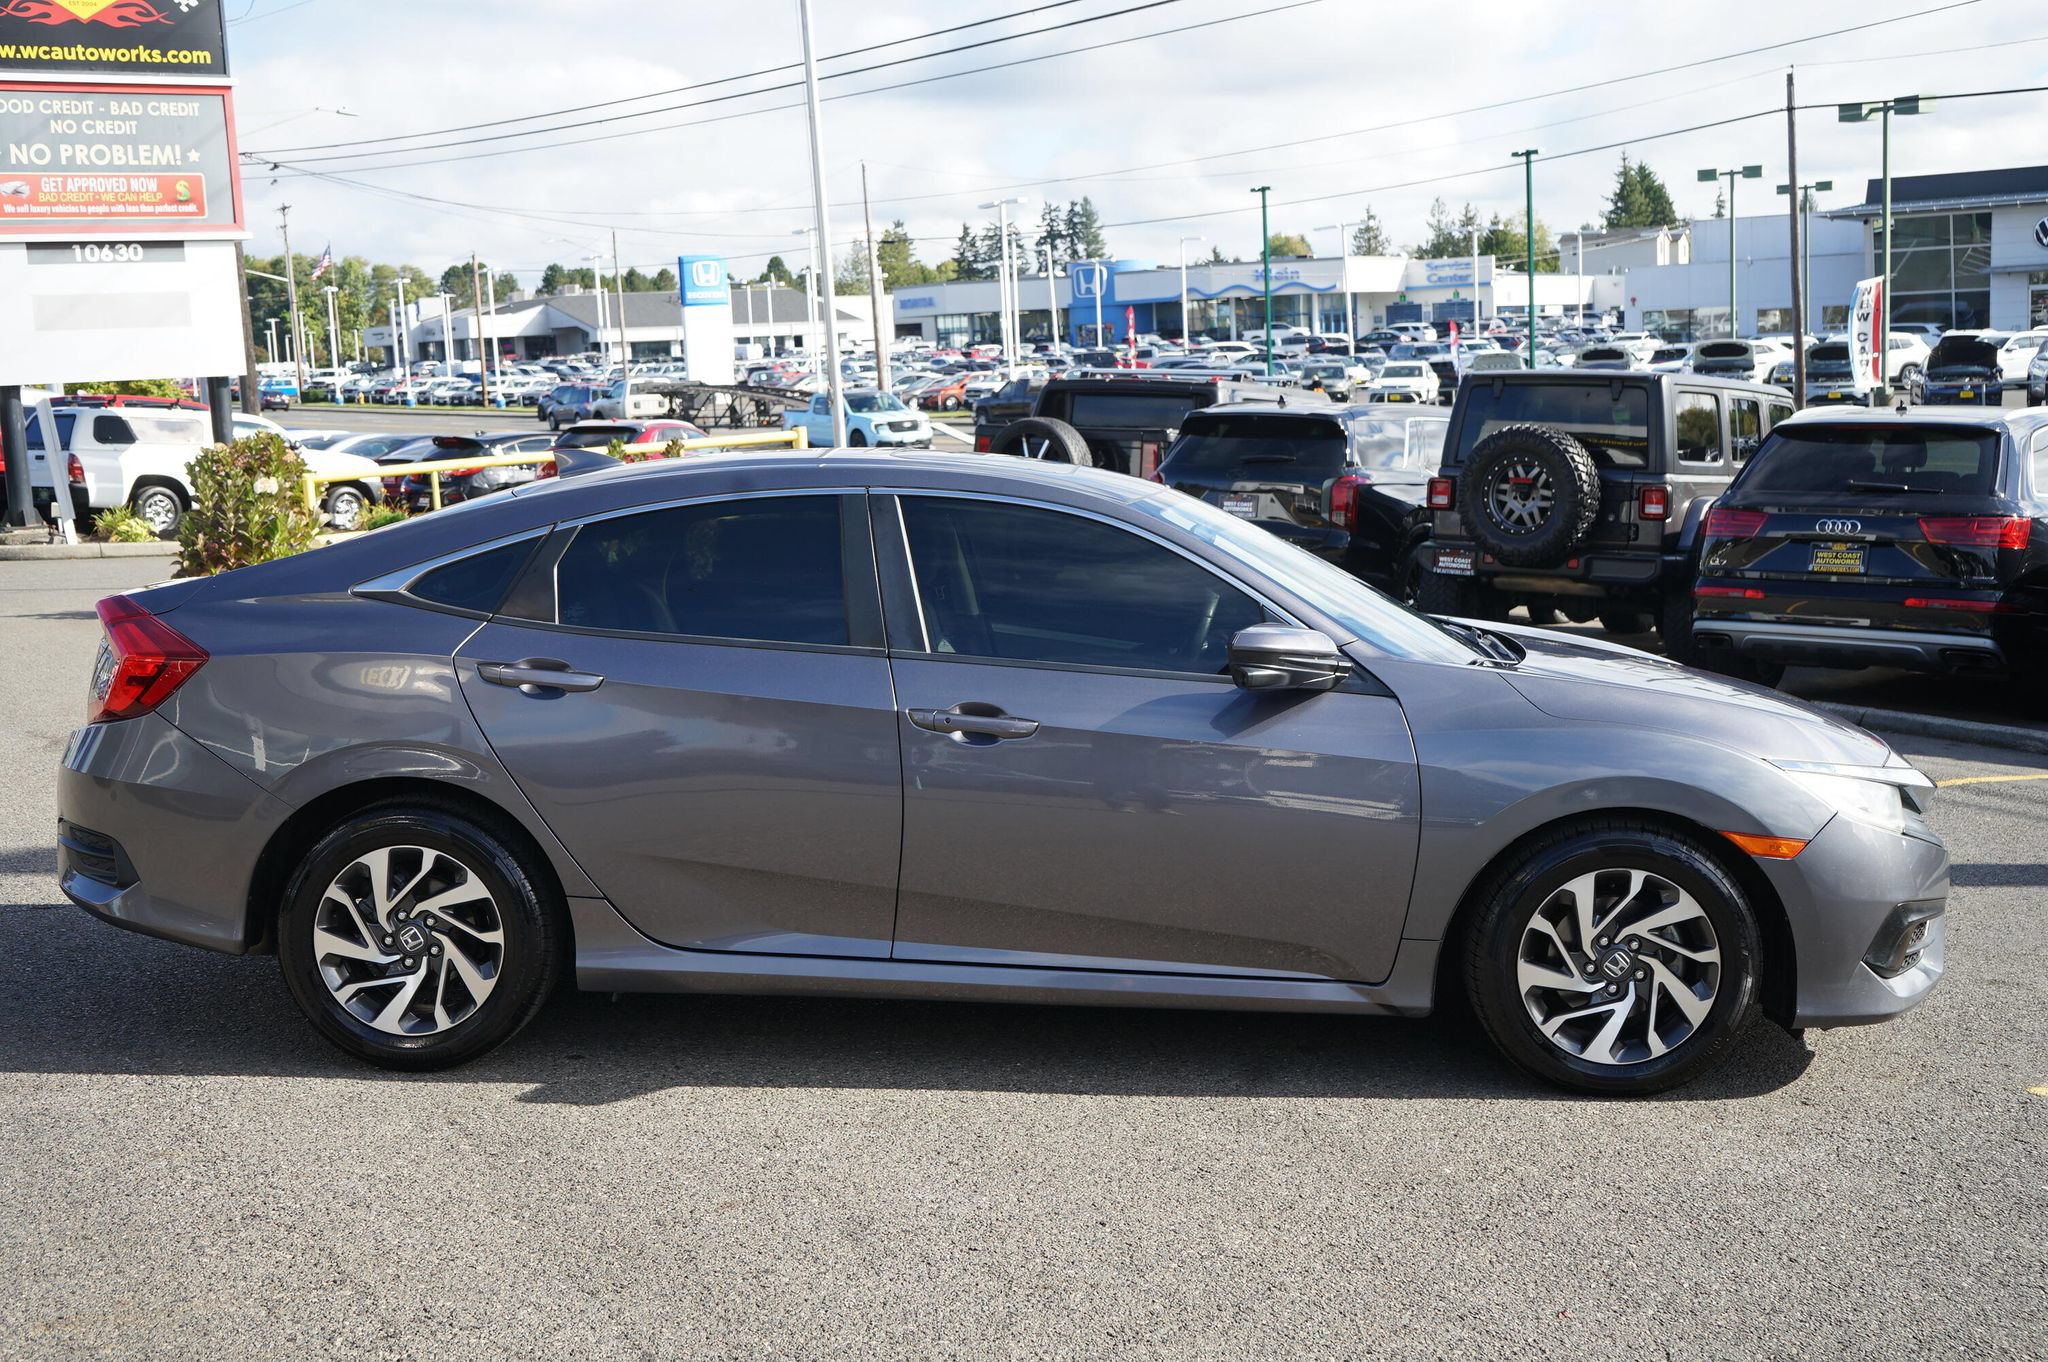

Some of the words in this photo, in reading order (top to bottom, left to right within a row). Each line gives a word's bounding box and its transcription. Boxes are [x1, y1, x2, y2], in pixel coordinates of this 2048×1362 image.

[39, 99, 94, 115] CREDIT
[110, 101, 143, 116] BAD
[147, 101, 200, 116] CREDIT
[49, 119, 77, 134] NO
[81, 119, 138, 135] CREDIT
[9, 143, 51, 166] NO
[59, 143, 182, 166] PROBLEM!
[41, 177, 63, 192] GET
[66, 177, 128, 192] APPROVED
[130, 177, 158, 192] NOW
[38, 192, 58, 202] BAD
[60, 192, 94, 202] CREDIT
[101, 192, 116, 202] WE
[117, 192, 138, 202] CAN
[139, 192, 163, 202] HELP
[3, 204, 16, 213] We
[72, 243, 144, 262] 10630
[1426, 273, 1472, 284] Center
